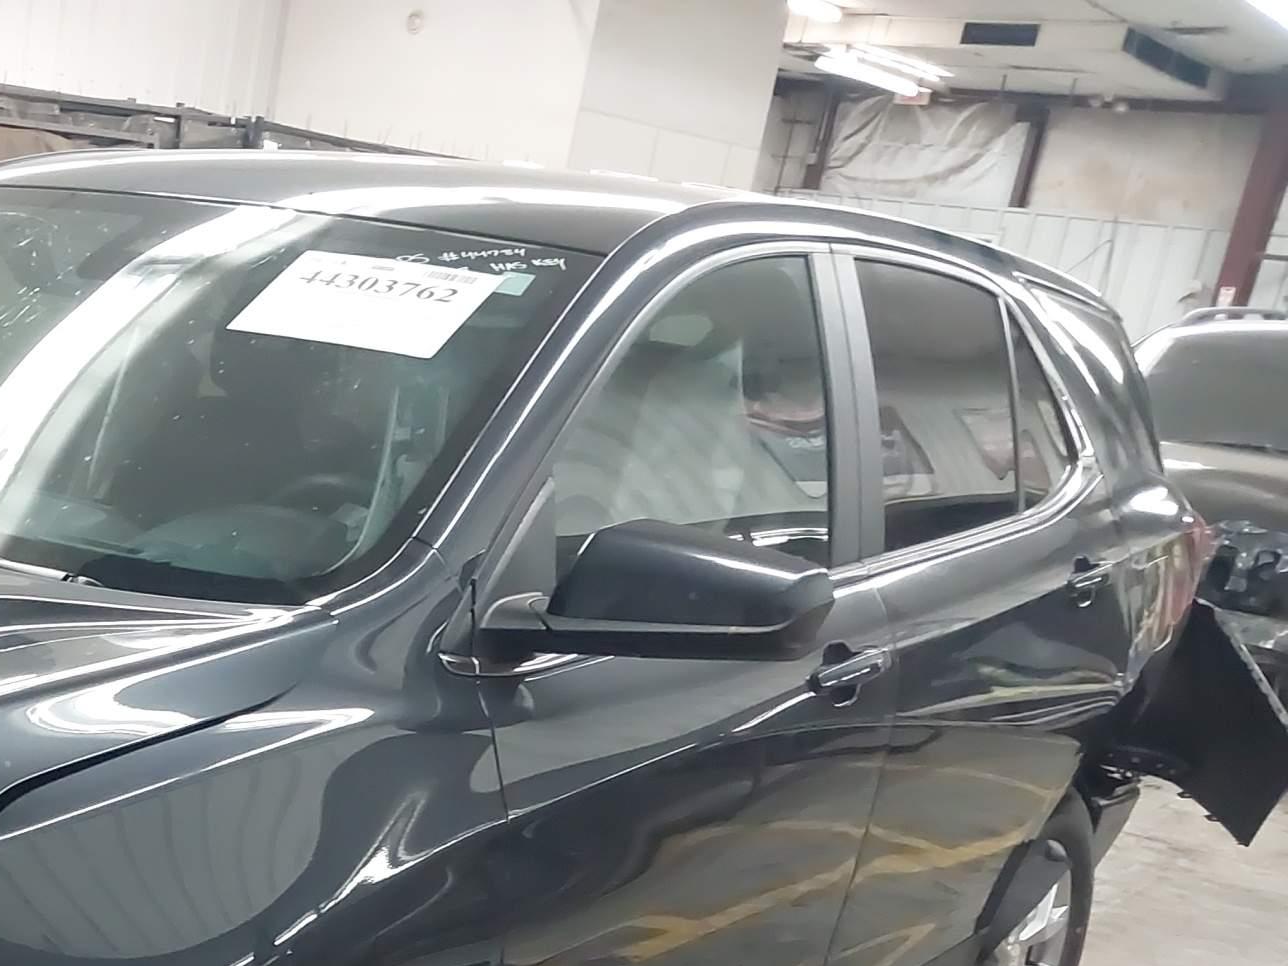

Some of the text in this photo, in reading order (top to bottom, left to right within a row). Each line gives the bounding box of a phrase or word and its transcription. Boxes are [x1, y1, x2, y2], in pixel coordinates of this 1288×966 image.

[490, 258, 567, 272] HAS KEY
[299, 270, 458, 303] 44303762
